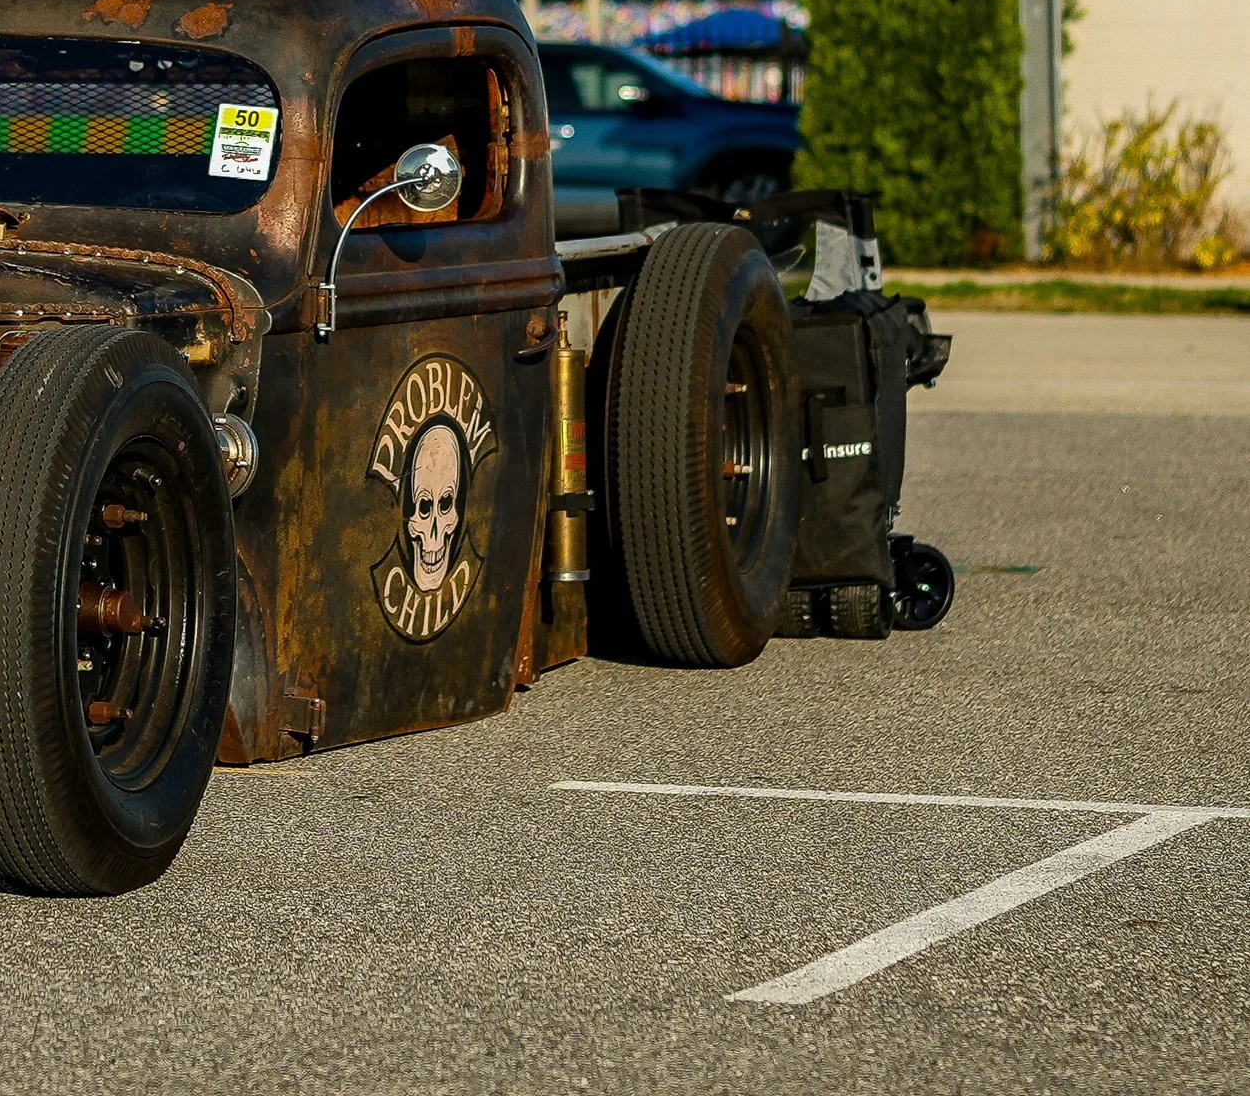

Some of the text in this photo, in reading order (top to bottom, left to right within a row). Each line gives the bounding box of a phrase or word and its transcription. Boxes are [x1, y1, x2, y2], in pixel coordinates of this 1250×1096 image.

[234, 109, 260, 127] 50
[372, 362, 492, 494] PROBLEM
[383, 559, 470, 637] CHILD
